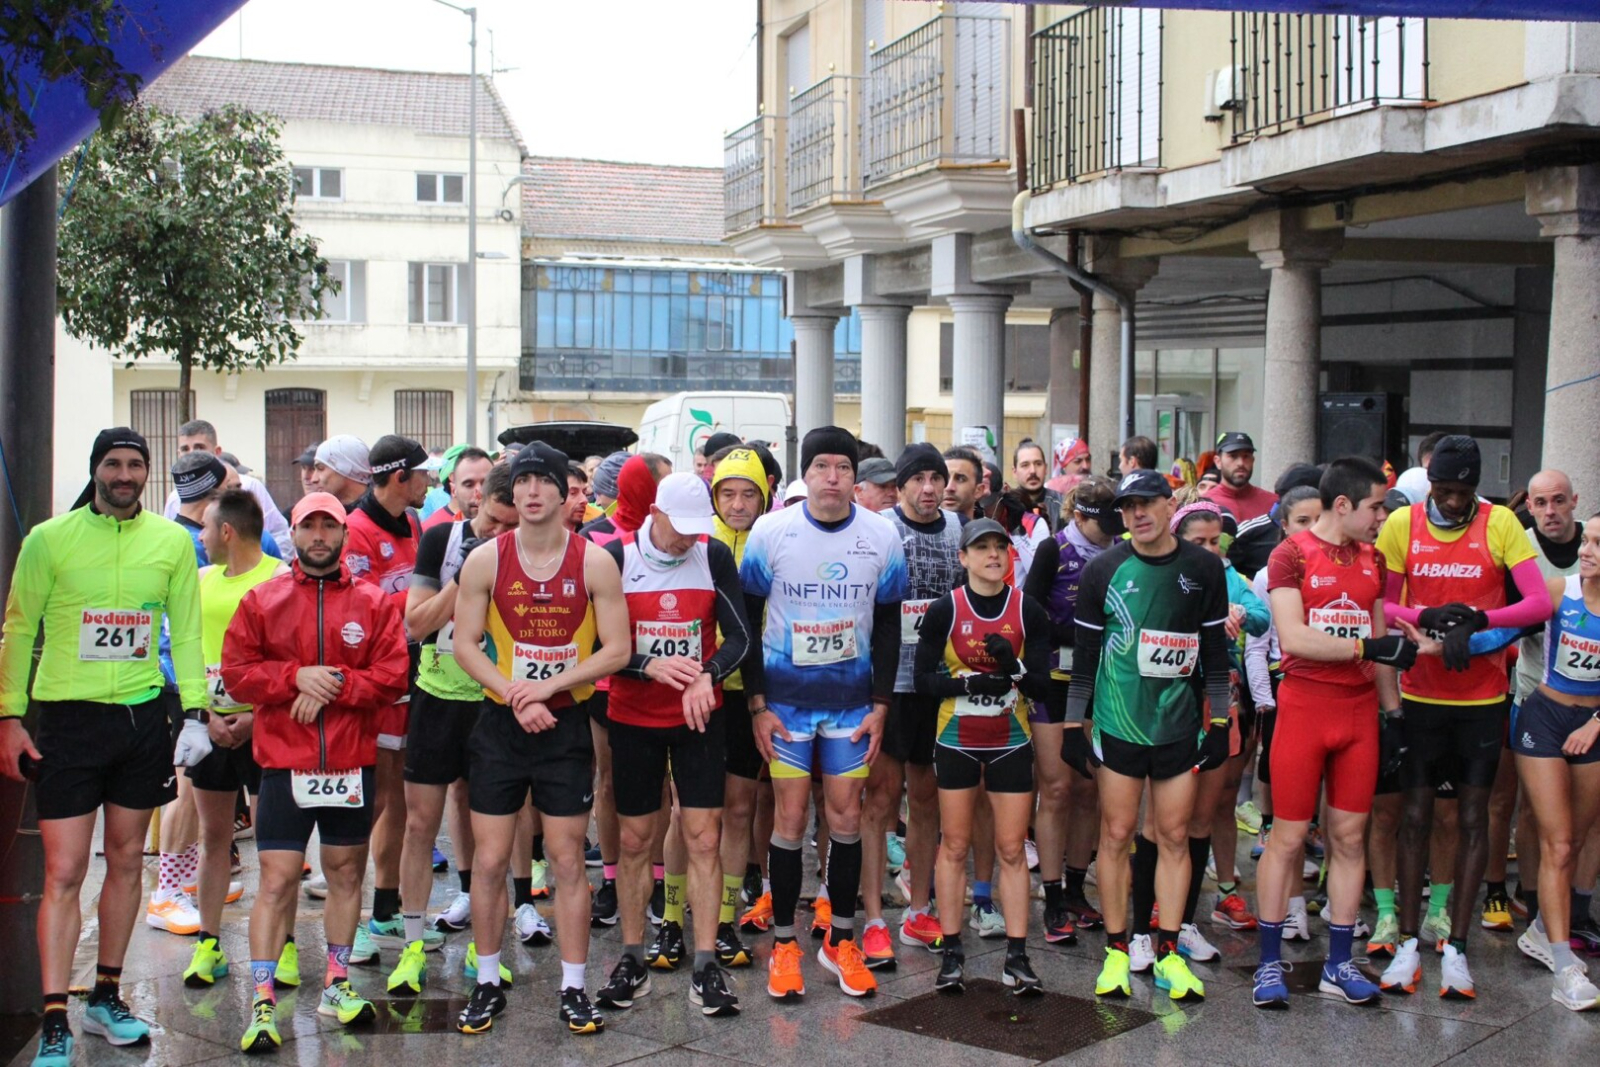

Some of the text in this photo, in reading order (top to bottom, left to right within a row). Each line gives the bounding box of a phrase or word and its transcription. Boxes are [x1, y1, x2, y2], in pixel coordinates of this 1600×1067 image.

[783, 581, 874, 600] INFINITY
[82, 611, 151, 626] bedunia
[529, 619, 558, 628] VINO
[1311, 611, 1370, 625] bedunia
[95, 627, 136, 647] 261
[519, 628, 567, 638] DE TORO
[1141, 632, 1198, 648] bedunia
[649, 639, 690, 657] 403
[806, 633, 843, 653] 275
[515, 645, 577, 662] bedunia
[1149, 648, 1187, 666] 440
[307, 778, 349, 796] 266
